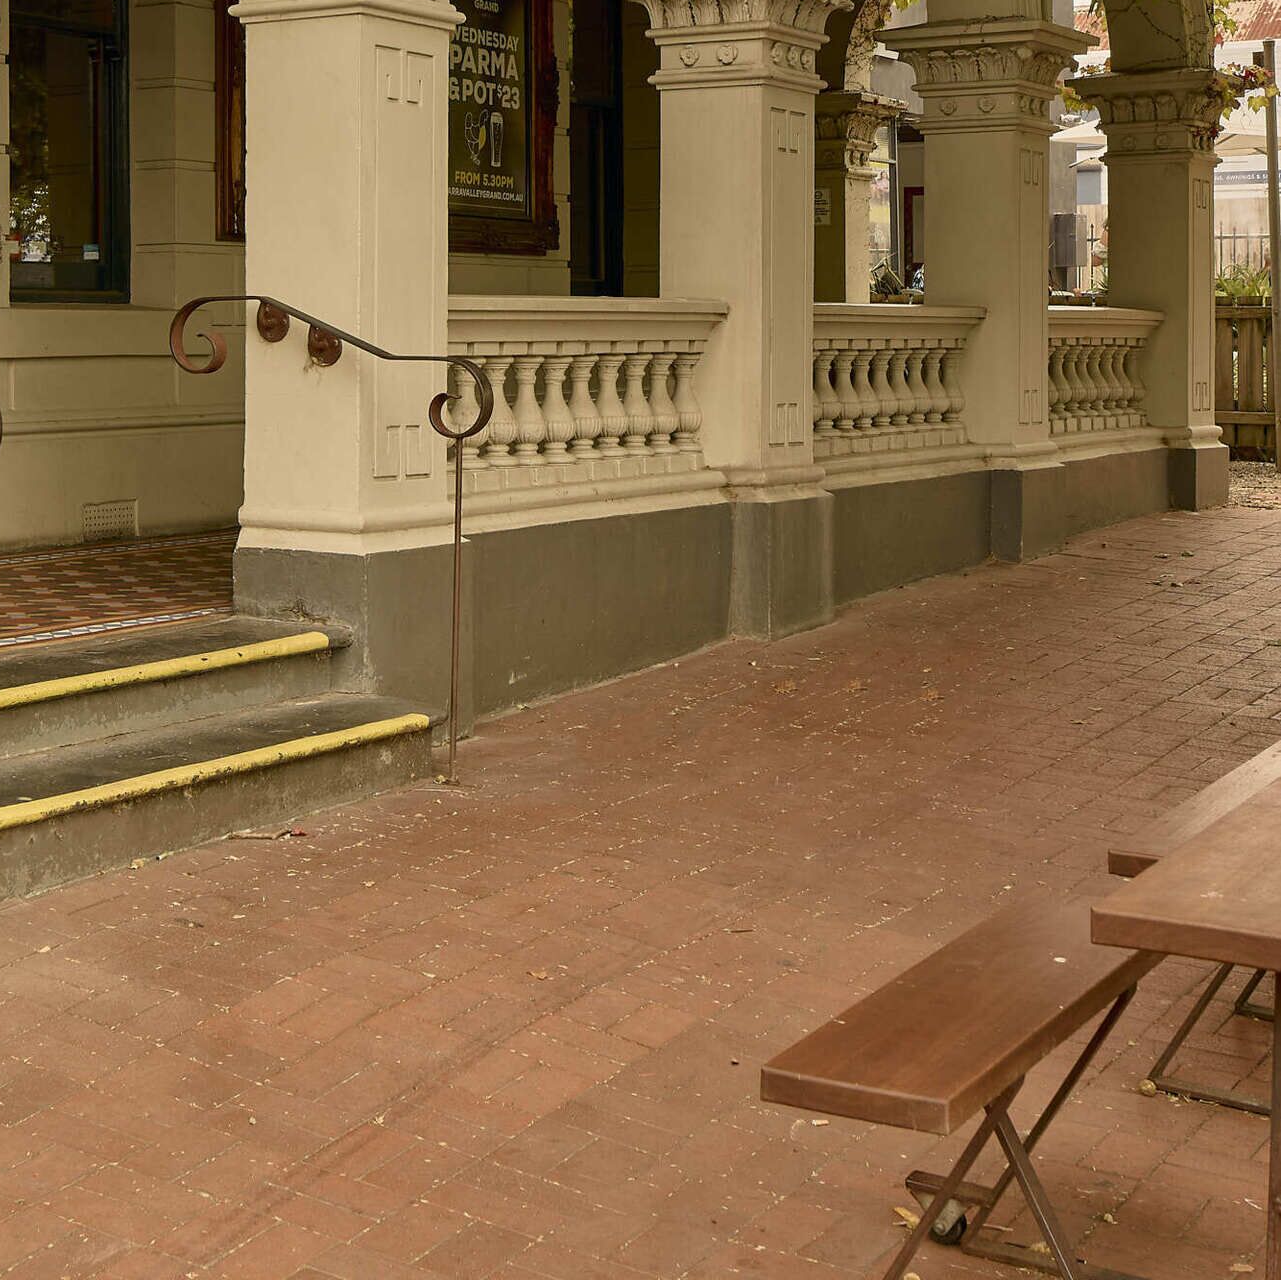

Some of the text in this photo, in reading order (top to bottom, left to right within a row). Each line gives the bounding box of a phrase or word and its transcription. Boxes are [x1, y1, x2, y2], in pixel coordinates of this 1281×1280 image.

[474, 0, 499, 13] GRAND
[449, 43, 519, 81] PARMA
[454, 171, 514, 189] FROM 5.30PM
